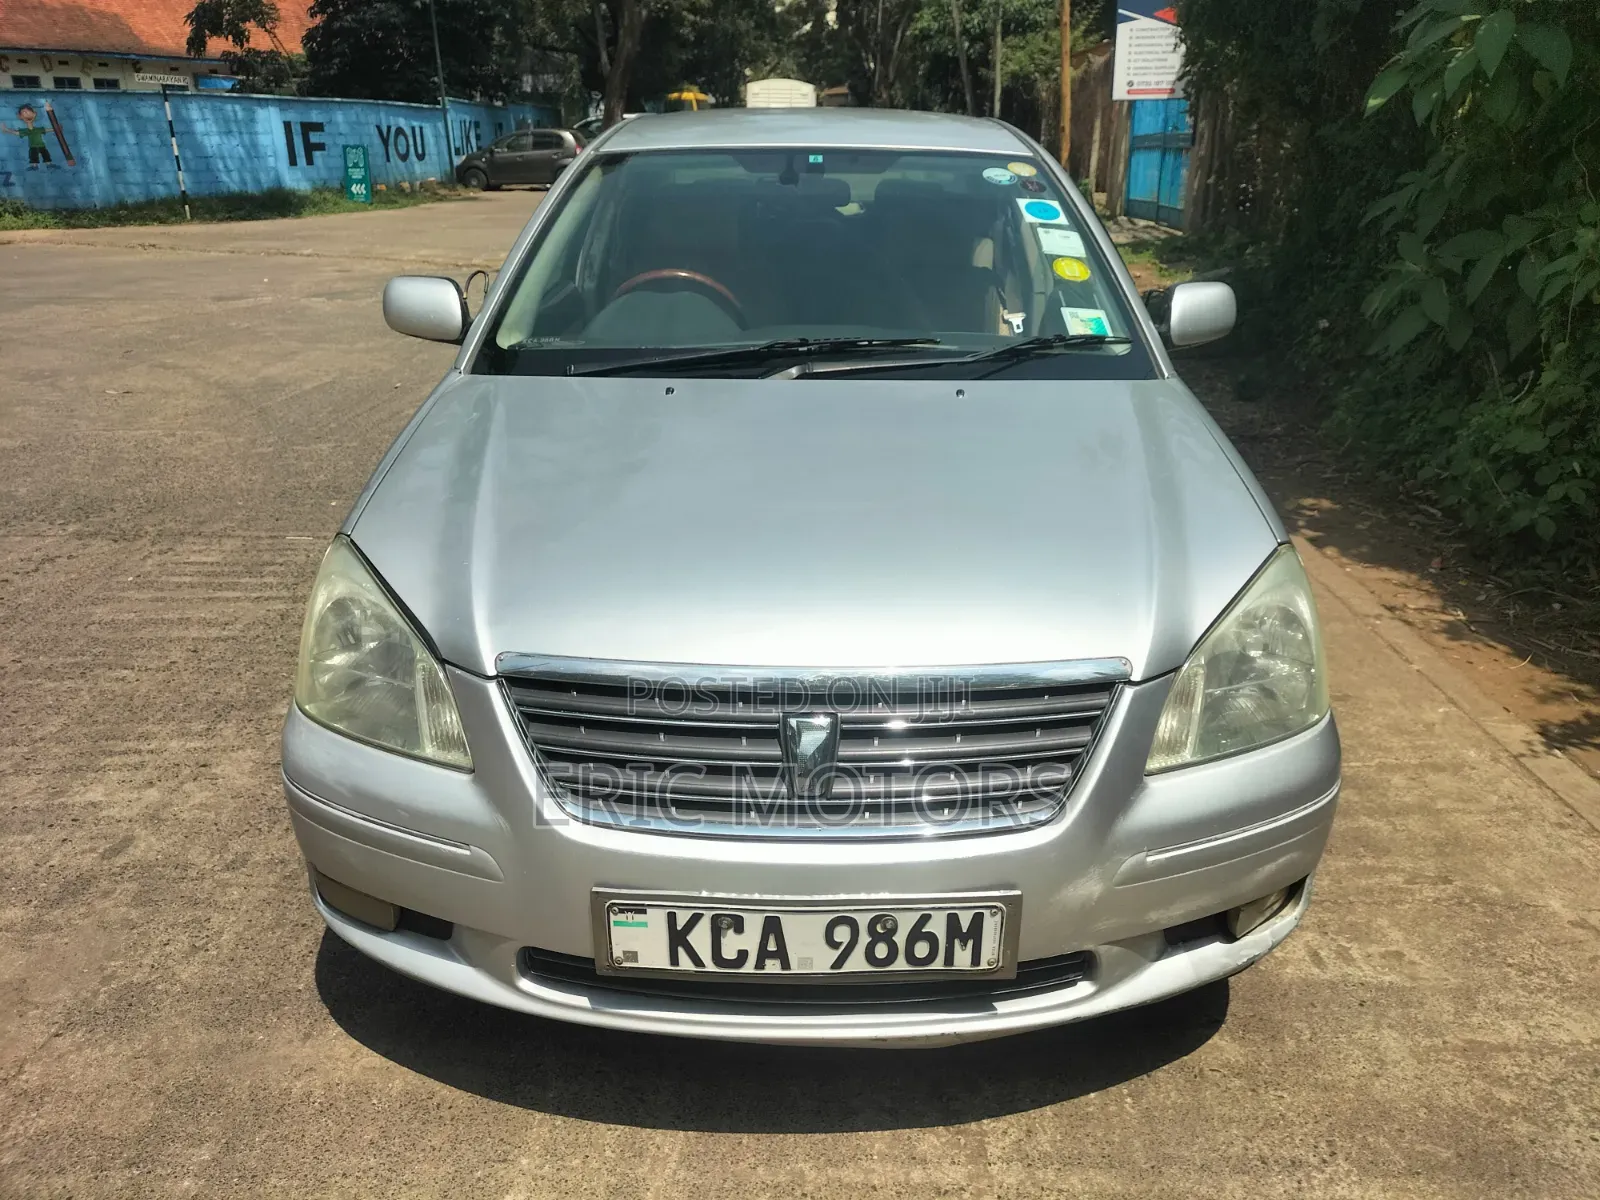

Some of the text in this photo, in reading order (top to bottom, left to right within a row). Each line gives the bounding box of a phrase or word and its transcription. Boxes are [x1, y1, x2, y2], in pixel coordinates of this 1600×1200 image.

[284, 120, 326, 166] IF
[375, 123, 425, 162] YOU
[451, 119, 482, 156] LIKE
[667, 911, 792, 970] KCA
[825, 911, 985, 971] 986M
